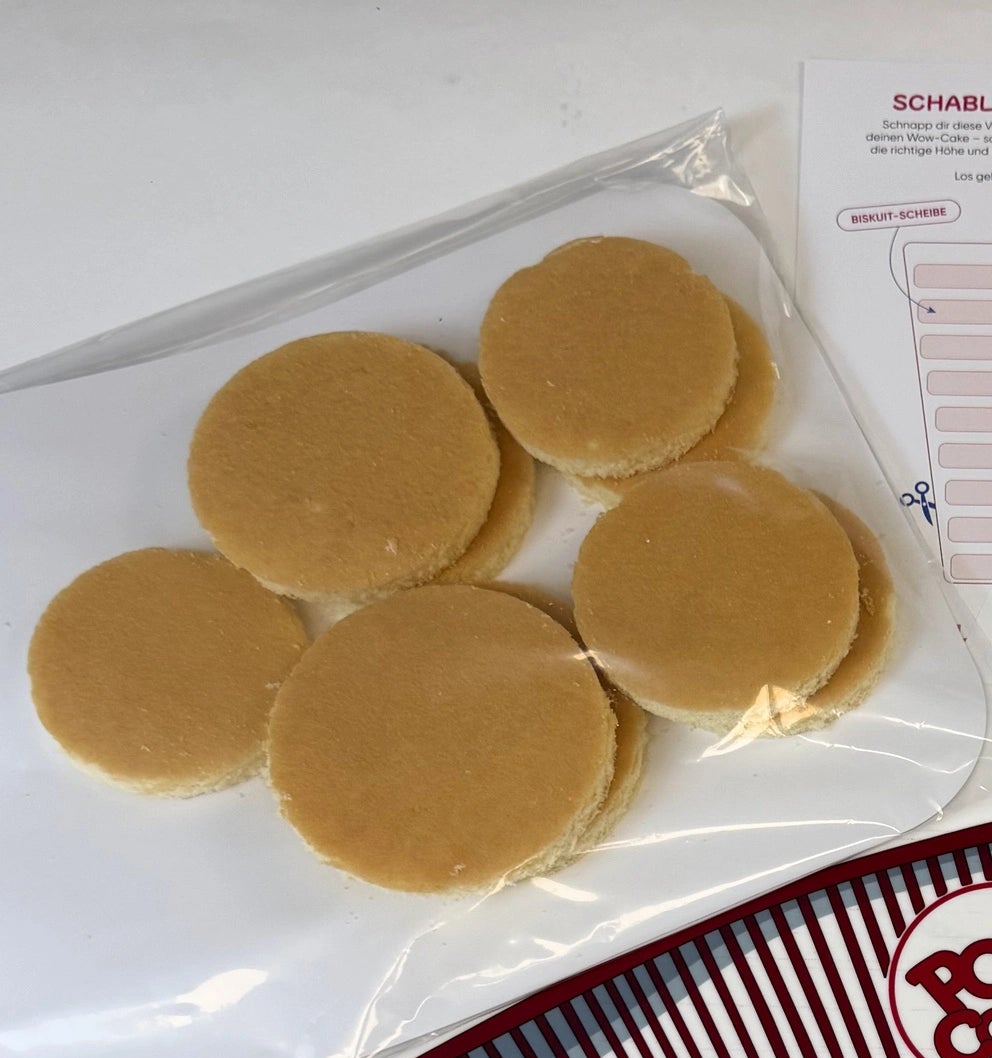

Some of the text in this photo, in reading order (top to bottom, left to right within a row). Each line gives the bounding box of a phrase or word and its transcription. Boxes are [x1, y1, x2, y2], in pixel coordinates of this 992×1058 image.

[882, 120, 933, 132] Schnapp
[935, 121, 949, 130] dir
[952, 121, 982, 131] diese
[866, 134, 904, 142] deinen
[906, 134, 970, 143] Wow-Cake
[870, 146, 888, 155] die
[890, 146, 932, 157] richtige
[935, 146, 965, 156] Höhe
[968, 147, 989, 156] und
[954, 172, 974, 181] Los
[851, 207, 947, 224] BISKUIT-SCHEIBE
